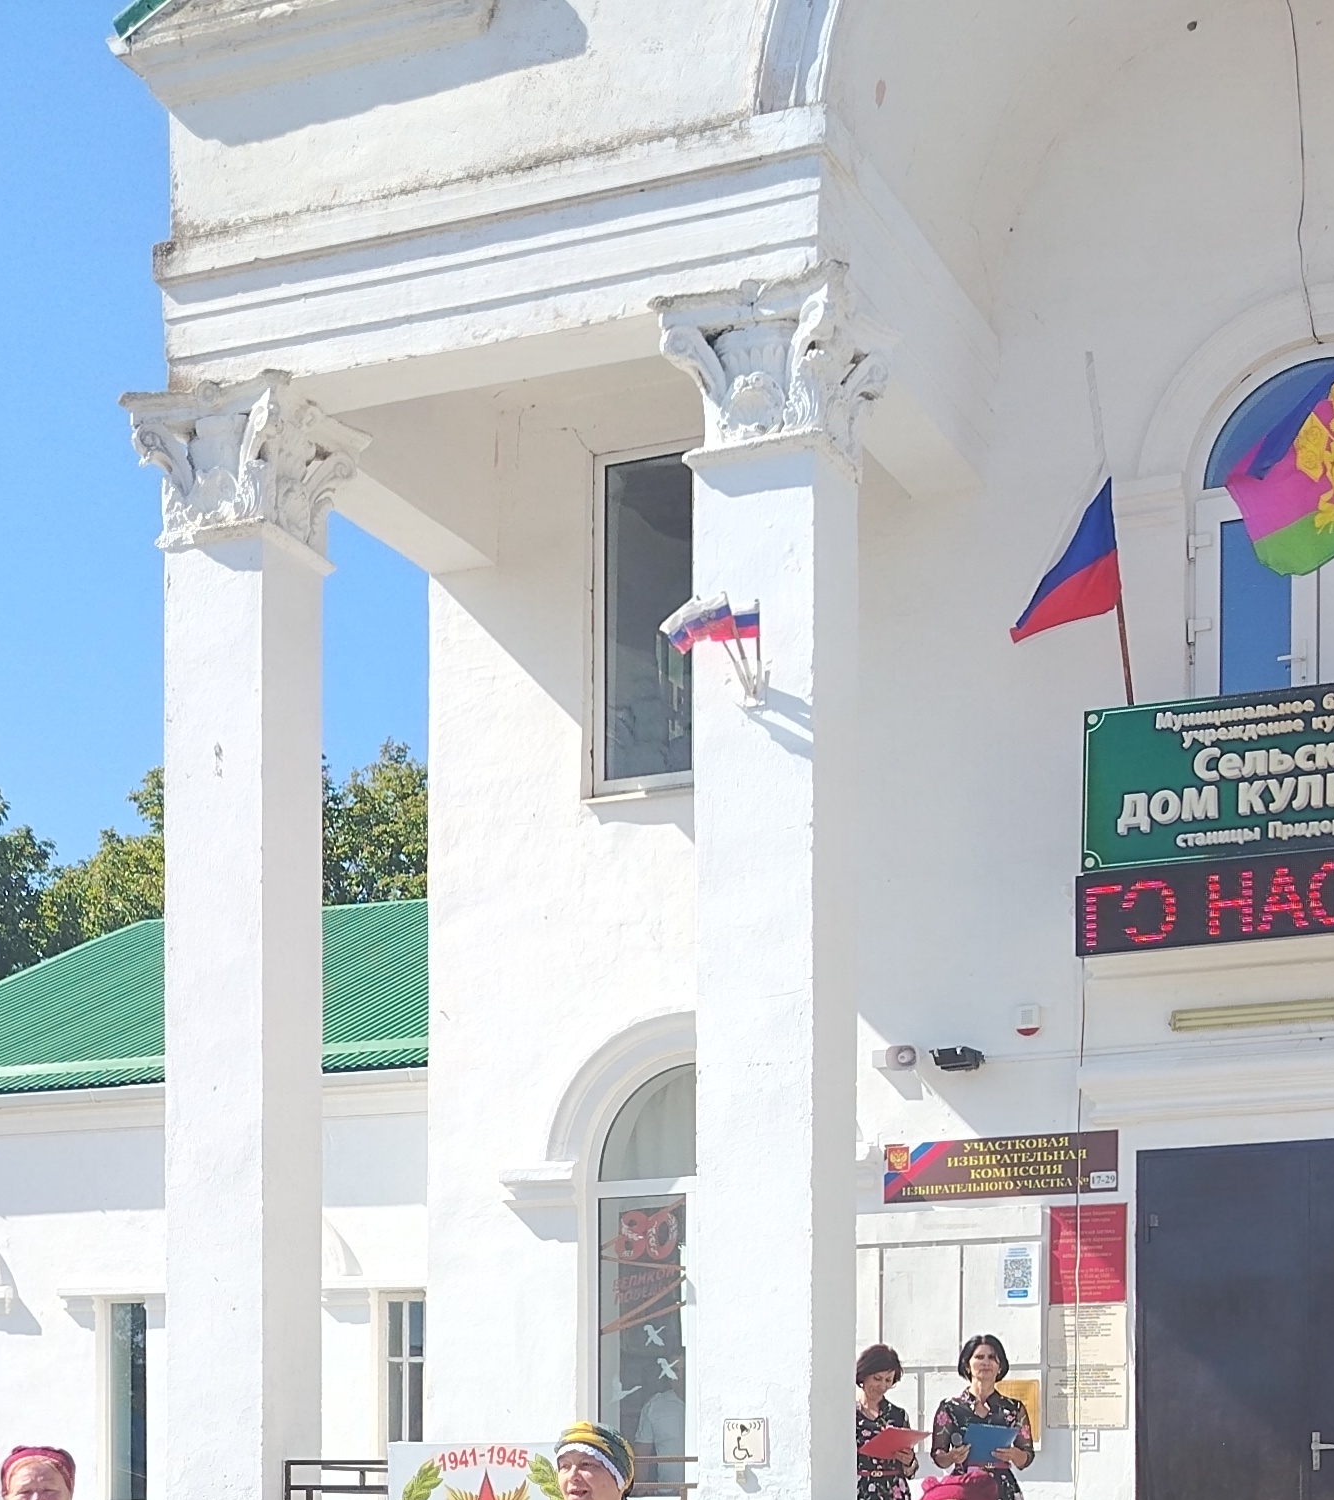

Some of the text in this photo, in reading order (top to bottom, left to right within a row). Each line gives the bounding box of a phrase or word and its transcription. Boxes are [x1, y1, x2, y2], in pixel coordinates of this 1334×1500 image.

[1155, 696, 1315, 731] Муниципальное
[1182, 718, 1305, 749] учреждение
[1117, 785, 1218, 835] ДОМ
[1175, 824, 1261, 848] станицы
[963, 1136, 1070, 1153] УЧАСТКОВАЯ
[946, 1148, 1087, 1168] ИЗБИРАТЕЛЬНАЯ
[970, 1164, 1063, 1179] КОМИССИЯ
[901, 1181, 1014, 1196] ИЗБИРАТЕЛЬНОГО
[1016, 1177, 1073, 1190] УЧАСТКА
[614, 1210, 678, 1260] 80
[437, 1445, 529, 1472] 1941-1945
